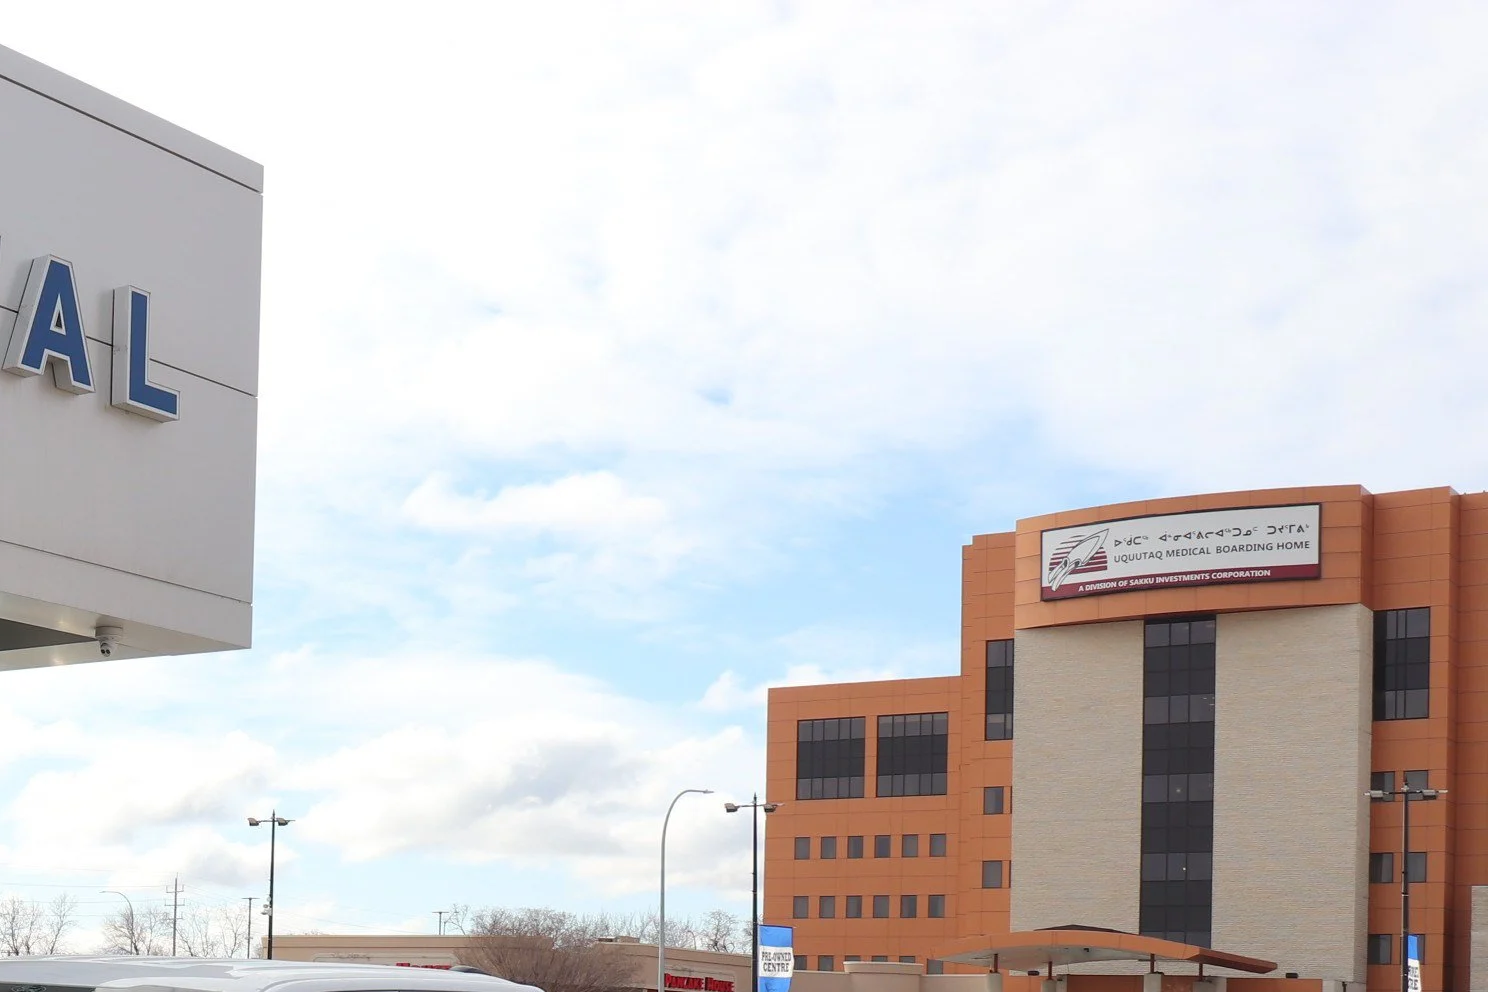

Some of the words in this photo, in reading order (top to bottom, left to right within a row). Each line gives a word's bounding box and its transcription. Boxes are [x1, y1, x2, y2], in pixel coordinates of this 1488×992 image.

[1114, 550, 1163, 563] UQUUTAQ
[1166, 547, 1211, 558] MEDICAL
[1216, 542, 1273, 554] BOARDING
[1276, 541, 1310, 550] HOME
[1085, 582, 1117, 591] DIVISION
[1119, 580, 1128, 588] OF
[1129, 577, 1154, 586] SAKKU
[1156, 573, 1210, 584] INVESTMENTS
[1212, 569, 1271, 579] CORPORATION
[761, 951, 791, 962] PRE-OWNED
[763, 962, 790, 973] CENTRE
[705, 977, 735, 992] HOUSE
